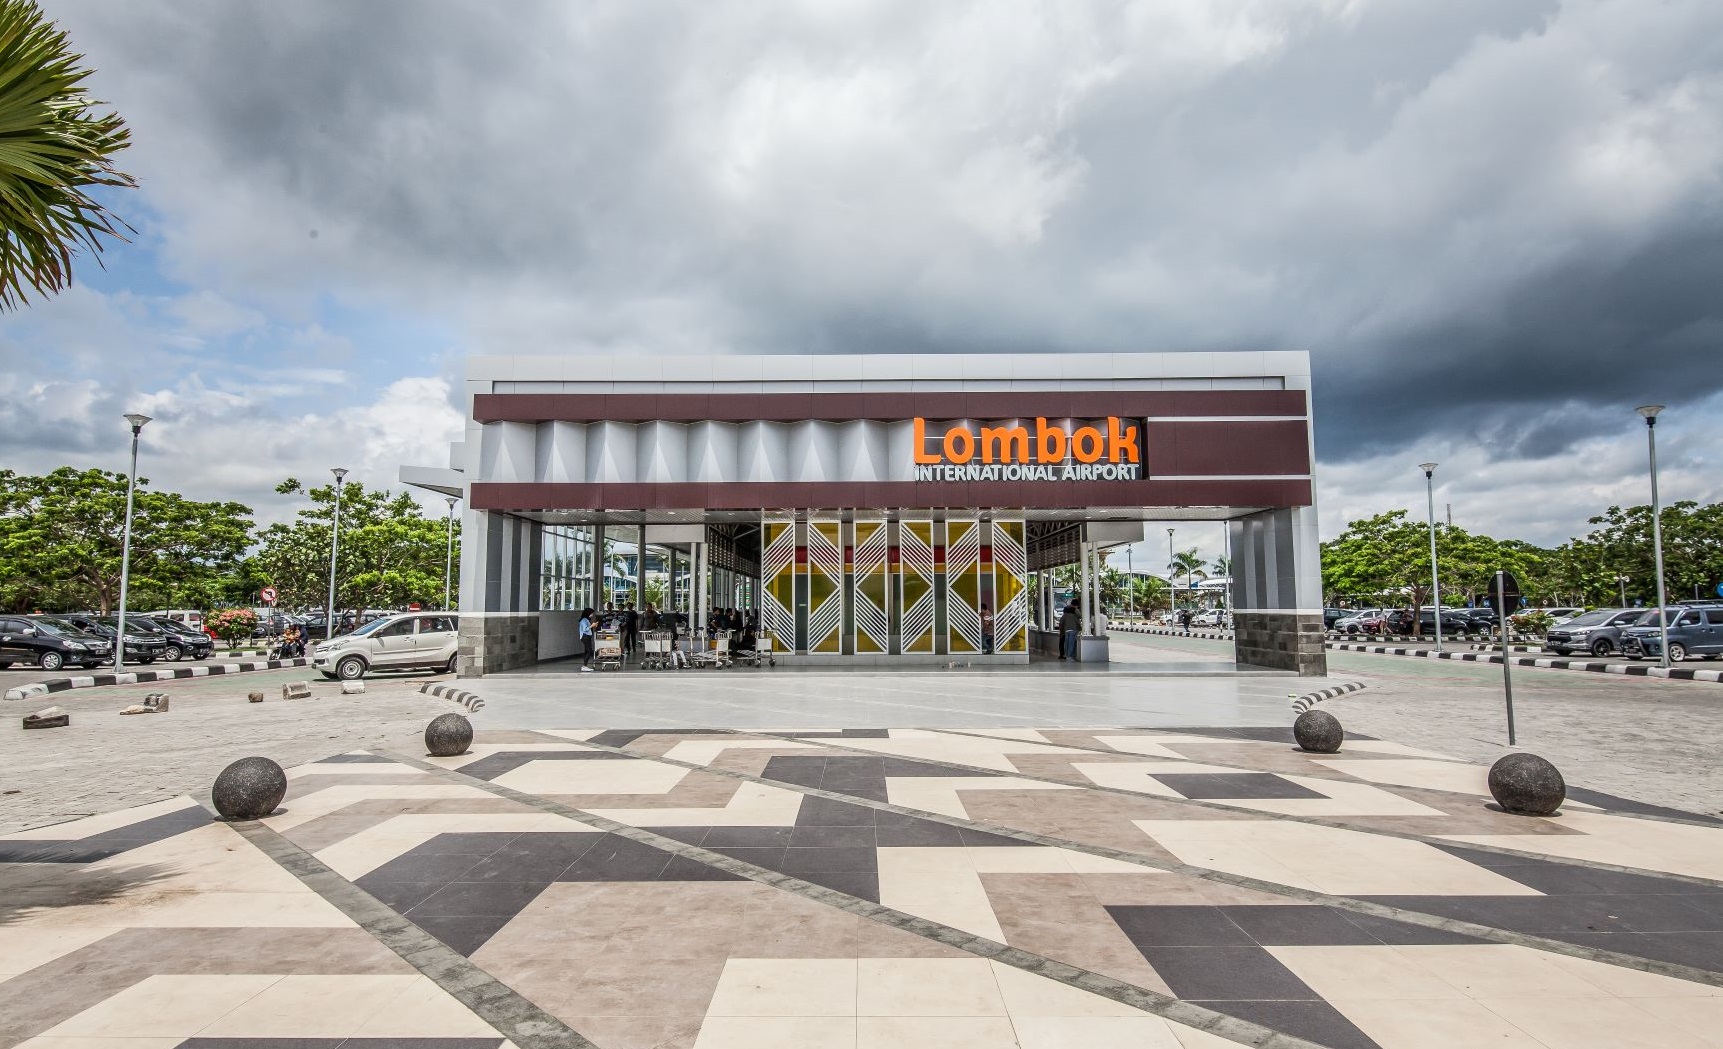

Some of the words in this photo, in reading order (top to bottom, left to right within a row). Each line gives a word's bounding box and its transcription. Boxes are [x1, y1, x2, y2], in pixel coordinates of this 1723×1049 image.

[913, 416, 1139, 463] Lombok
[914, 464, 1057, 481] INTERNATIONAL
[1061, 464, 1139, 481] AIRPORT
